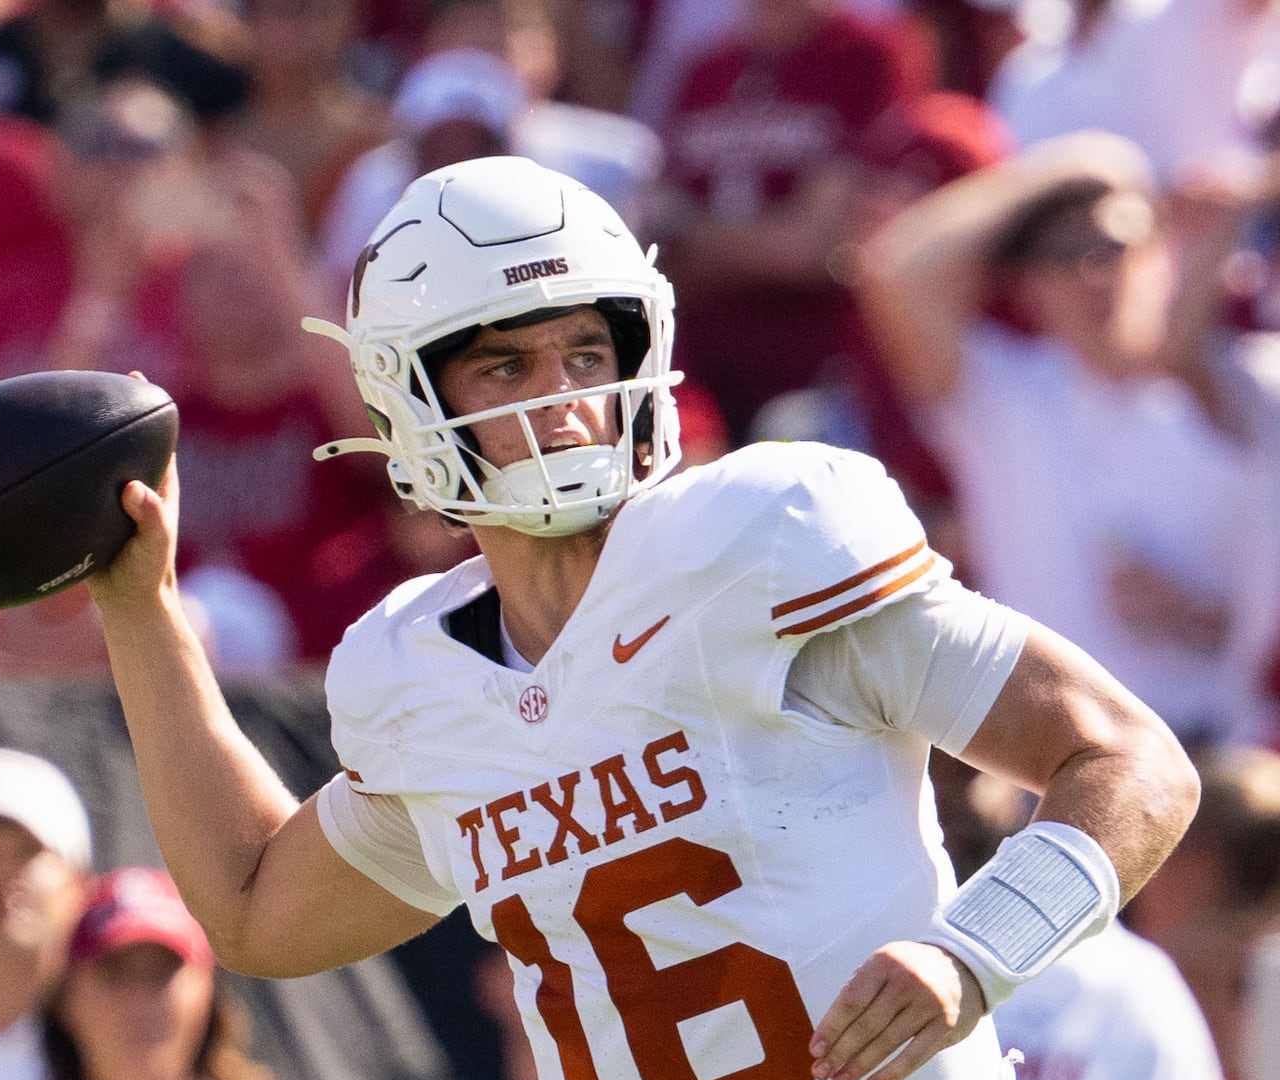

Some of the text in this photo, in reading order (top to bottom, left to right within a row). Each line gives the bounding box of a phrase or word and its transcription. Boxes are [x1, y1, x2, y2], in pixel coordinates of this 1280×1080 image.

[502, 256, 569, 286] HORNS
[519, 686, 548, 723] SEC
[455, 730, 708, 893] TEXAS
